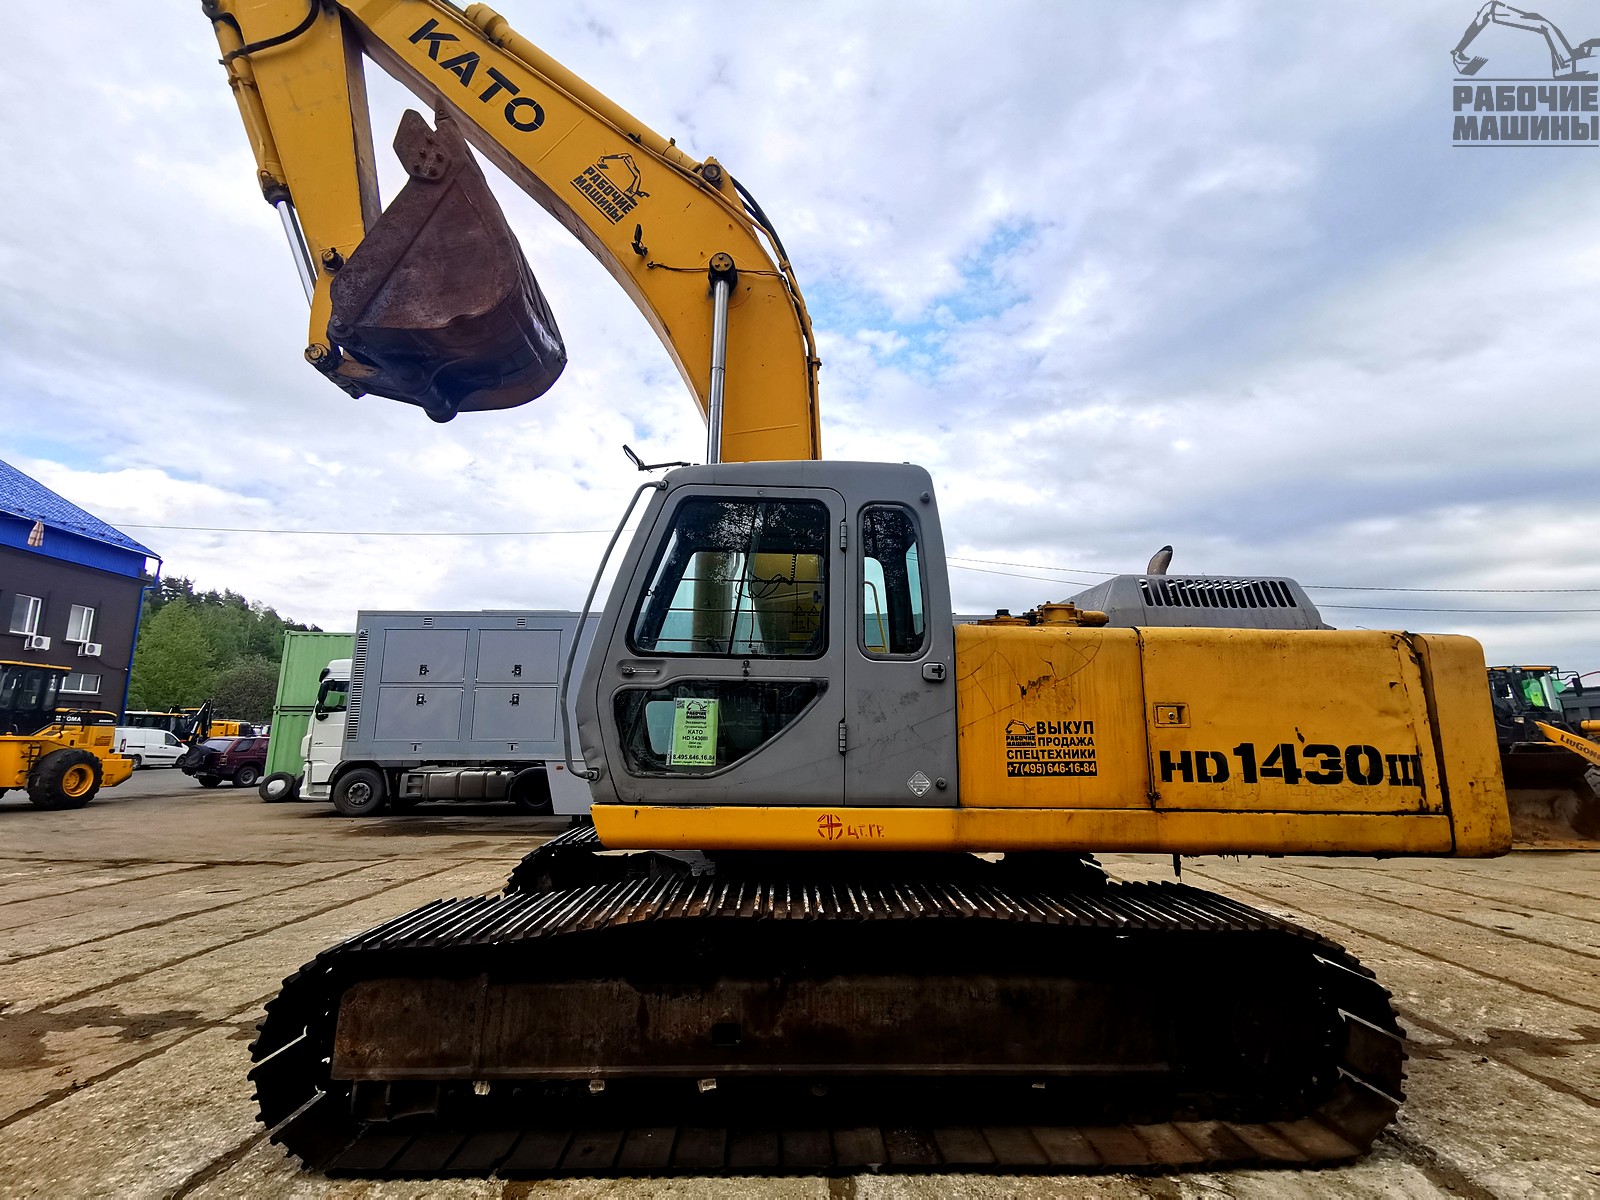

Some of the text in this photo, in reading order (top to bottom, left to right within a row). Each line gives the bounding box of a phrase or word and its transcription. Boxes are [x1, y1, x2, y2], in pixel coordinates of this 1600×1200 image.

[408, 18, 545, 132] KATO
[572, 174, 625, 223] МАШИНЫ
[582, 165, 635, 215] РАБОЧИЕ
[1036, 721, 1094, 735] ВЫКУП
[1038, 736, 1095, 748] ПРОДАЖА
[1006, 749, 1096, 761] СПЕЦТЕХНИКИ
